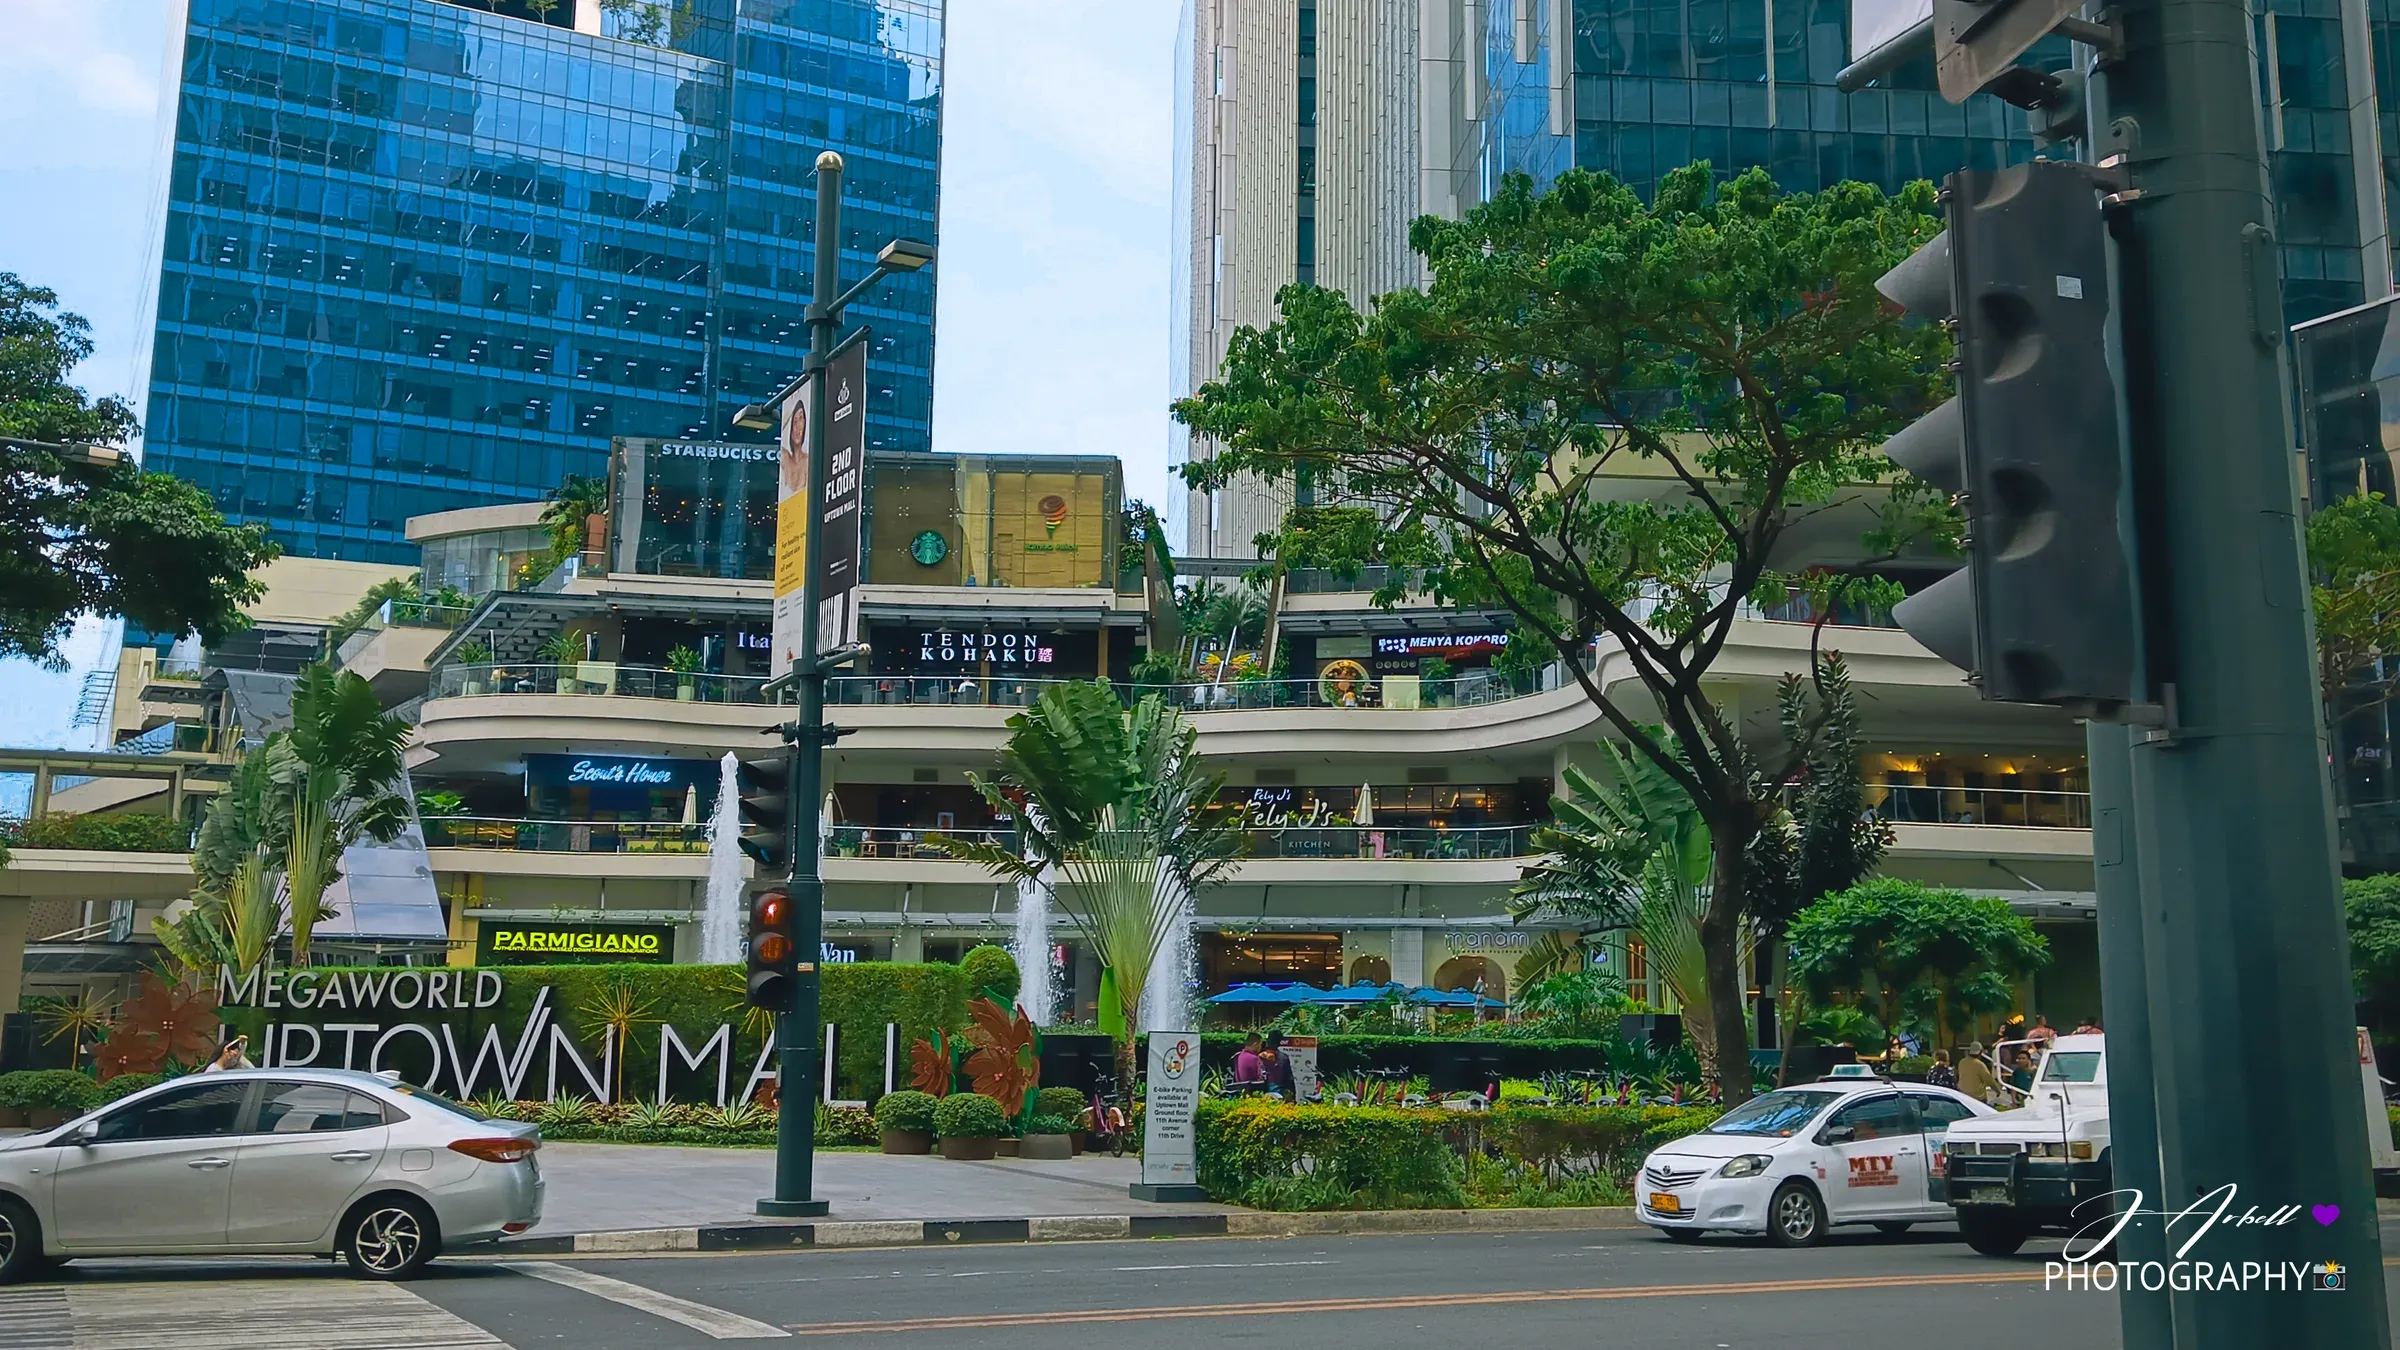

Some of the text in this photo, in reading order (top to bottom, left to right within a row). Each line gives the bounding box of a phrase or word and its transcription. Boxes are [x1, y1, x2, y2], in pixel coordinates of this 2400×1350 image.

[662, 443, 762, 461] STARBUCKS
[831, 446, 852, 476] 2ND
[825, 468, 856, 503] FLOOR
[920, 633, 1038, 647] TENDON
[1409, 636, 1452, 647] MENYA
[920, 647, 1037, 662] KOHAKU
[568, 760, 671, 783] Scout's Honor
[1253, 788, 1292, 805] Pely J's
[1297, 799, 1334, 828] J's
[1288, 840, 1331, 849] KITCHEN
[494, 931, 658, 949] PARMIGIANO
[1444, 931, 1530, 949] manam
[217, 963, 502, 1009] MEGAWORLD
[1171, 1086, 1192, 1094] Parking
[1848, 1155, 1894, 1172] MTY
